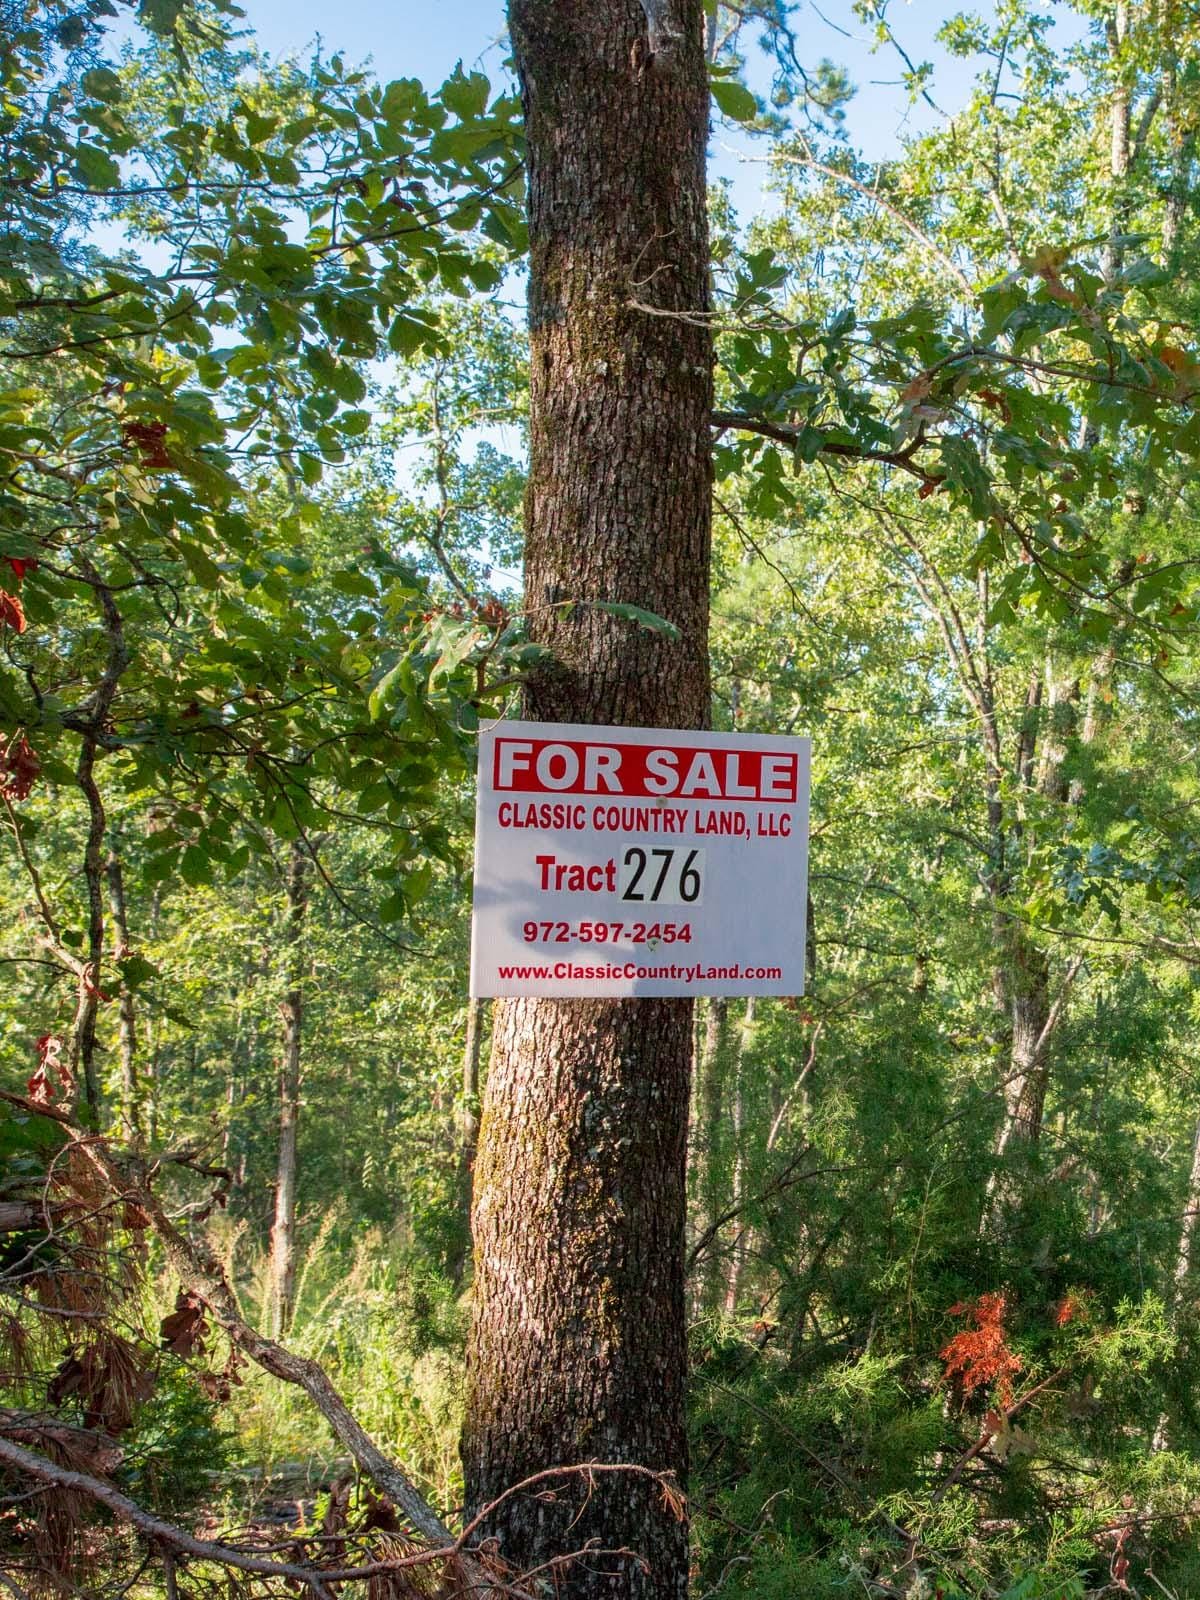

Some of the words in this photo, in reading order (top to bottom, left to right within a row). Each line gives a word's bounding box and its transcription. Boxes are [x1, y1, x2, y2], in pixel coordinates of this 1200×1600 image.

[498, 742, 623, 793] FOR
[643, 749, 794, 800] SALE
[498, 802, 586, 830] CLASSIC
[592, 806, 688, 833] COUNTRY
[695, 811, 751, 840] LAND,
[757, 813, 791, 837] LLC
[535, 855, 616, 892] Tract
[622, 847, 701, 902] 276
[523, 921, 692, 943] 972-597-2454
[498, 962, 782, 982] www.ClassicCountryLand.com
